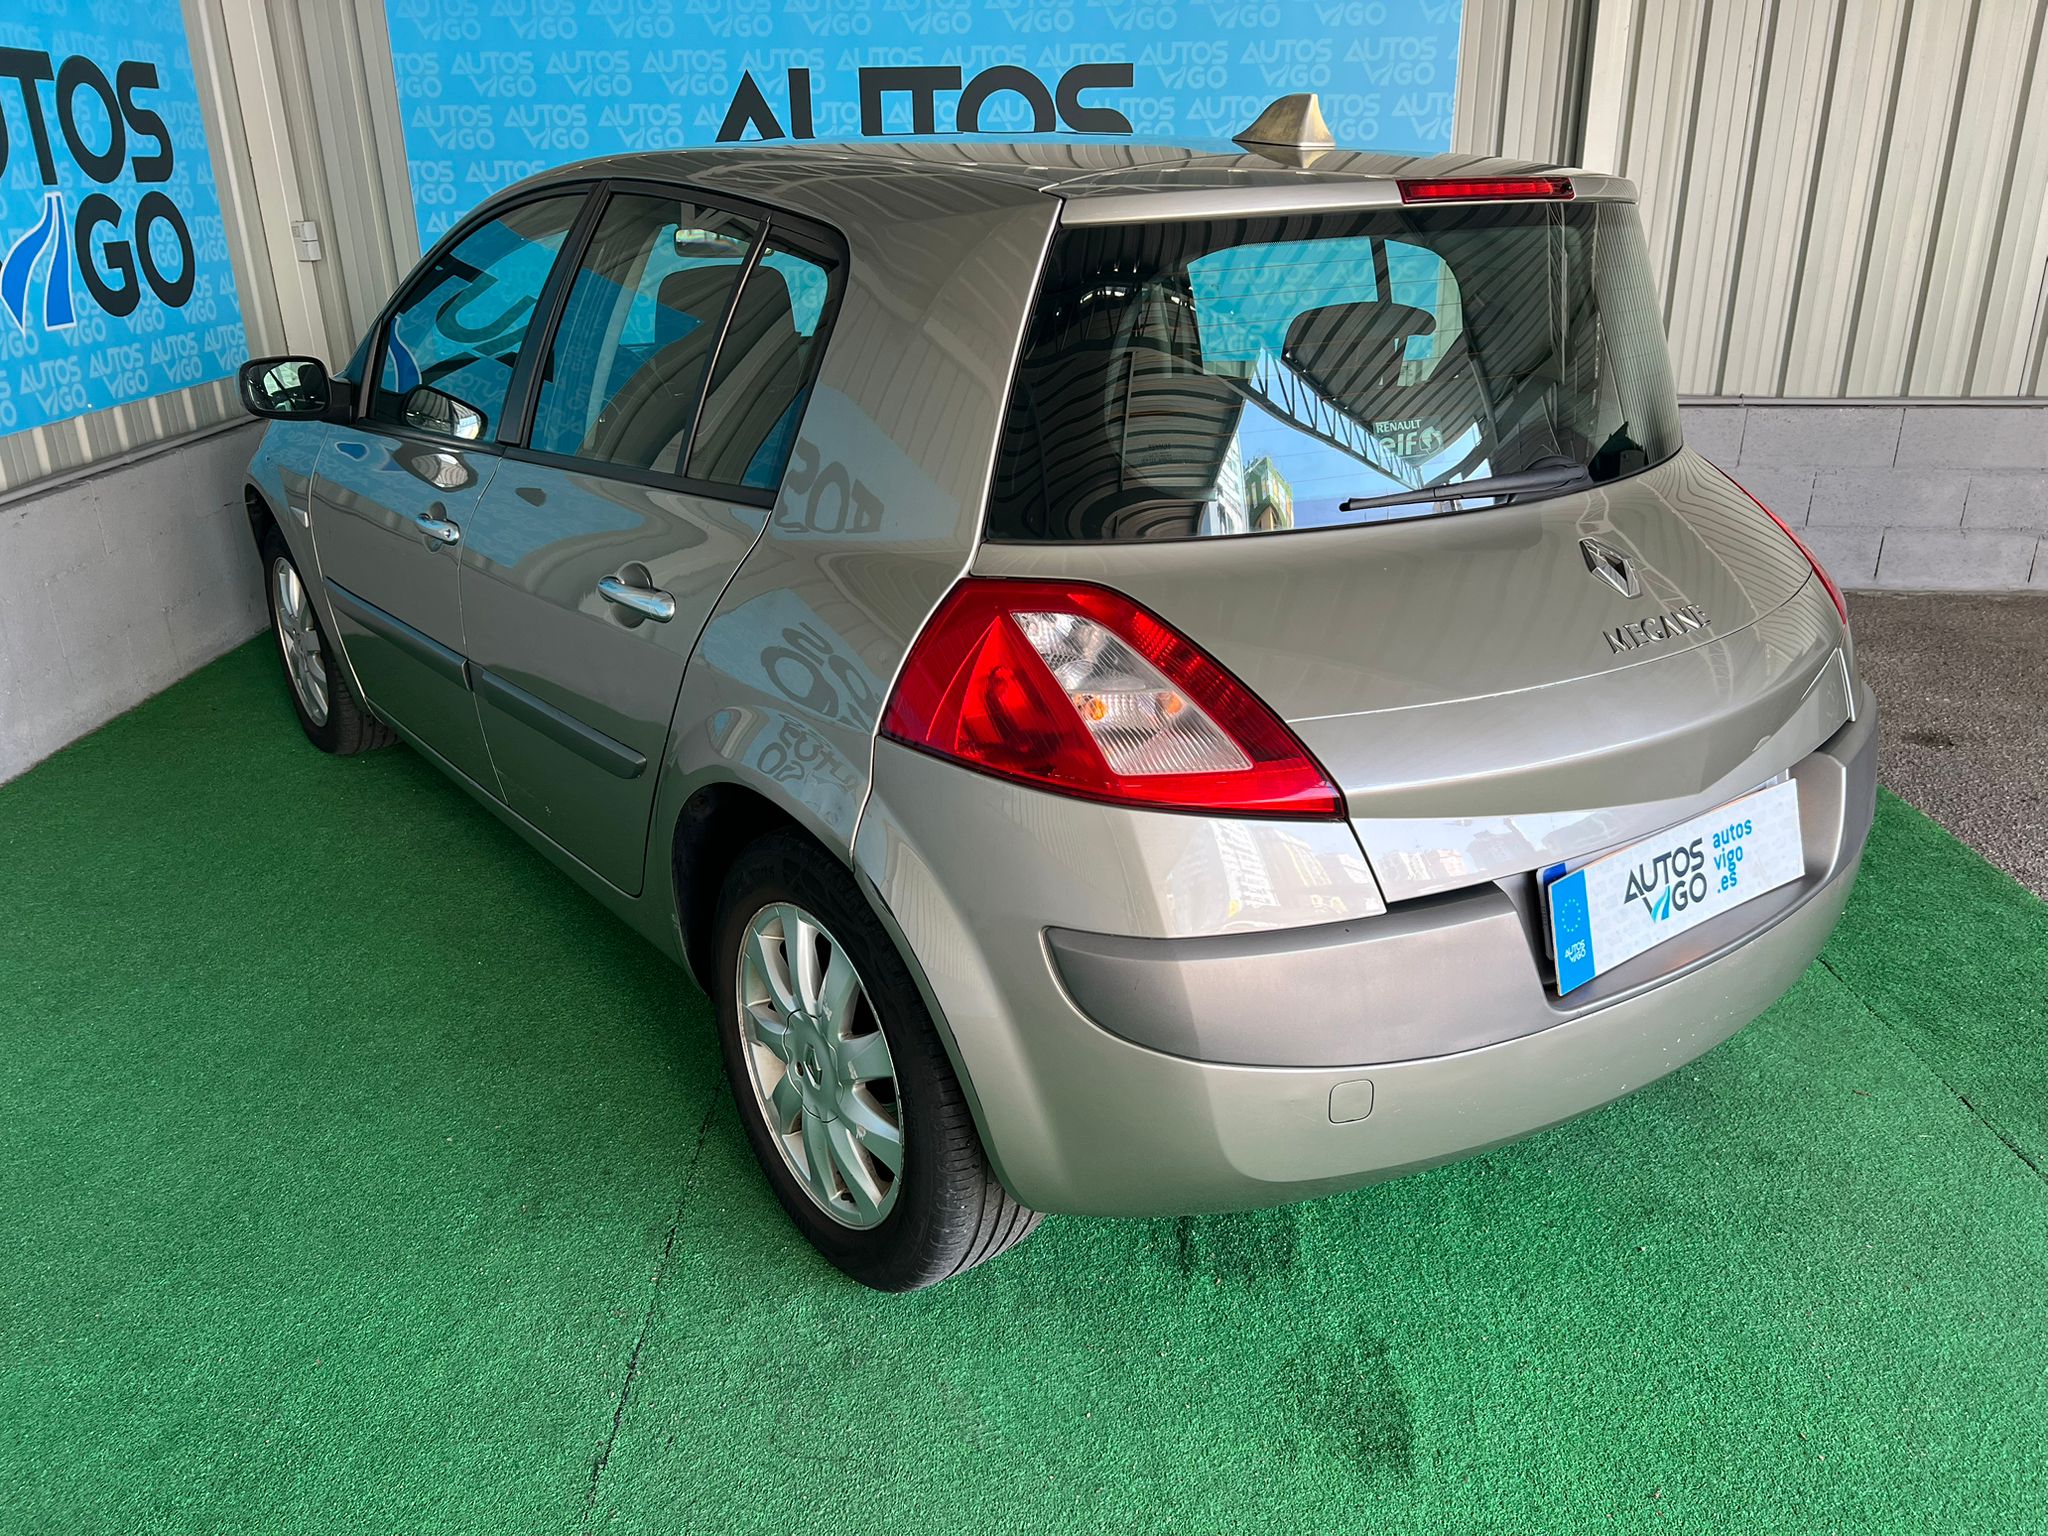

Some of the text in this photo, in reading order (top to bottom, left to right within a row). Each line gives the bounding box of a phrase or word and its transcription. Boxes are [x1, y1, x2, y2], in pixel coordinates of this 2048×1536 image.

[702, 13, 773, 38] VIGO
[802, 12, 872, 36] VIGO
[901, 10, 972, 34] VIGO
[1003, 8, 1074, 33] VIGO
[1104, 6, 1177, 31] VIGO
[1208, 4, 1280, 29] VIGO
[1313, 1, 1387, 26] VIGO
[414, 16, 481, 41] VIGO
[507, 15, 578, 40] VIGO
[604, 14, 676, 39] VIGO
[641, 48, 728, 73] AUTOS
[1139, 40, 1229, 65] AUTOS
[1240, 38, 1333, 63] AUTOS
[1343, 36, 1438, 62] AUTOS
[450, 51, 535, 75] AUTOS
[545, 50, 631, 74] AUTOS
[1260, 61, 1331, 87] VIGO
[1363, 60, 1435, 86] VIGO
[467, 74, 537, 98] VIGO
[562, 73, 633, 98] VIGO
[660, 72, 729, 97] VIGO
[1157, 64, 1228, 89] VIGO
[412, 104, 494, 128] AUTOS
[503, 103, 588, 127] AUTOS
[598, 102, 684, 127] AUTOS
[427, 127, 496, 151] VIGO
[521, 126, 590, 150] VIGO
[615, 126, 685, 149] VIGO
[90, 342, 143, 379] AUTOS
[151, 331, 198, 365] AUTOS
[20, 356, 81, 394] AUTOS
[161, 355, 202, 384] VIGO
[102, 368, 148, 400] VIGO
[34, 383, 87, 416] VIGO
[1376, 419, 1422, 434] RENAULT
[1380, 432, 1418, 456] elf
[1603, 604, 1712, 654] MEGANE
[1712, 819, 1753, 849] autos
[1623, 838, 1705, 905] AUTOS
[1713, 846, 1744, 875] vigo
[1717, 871, 1738, 894] .es
[1642, 872, 1708, 923] VIGO
[1564, 939, 1586, 958] AUTOS
